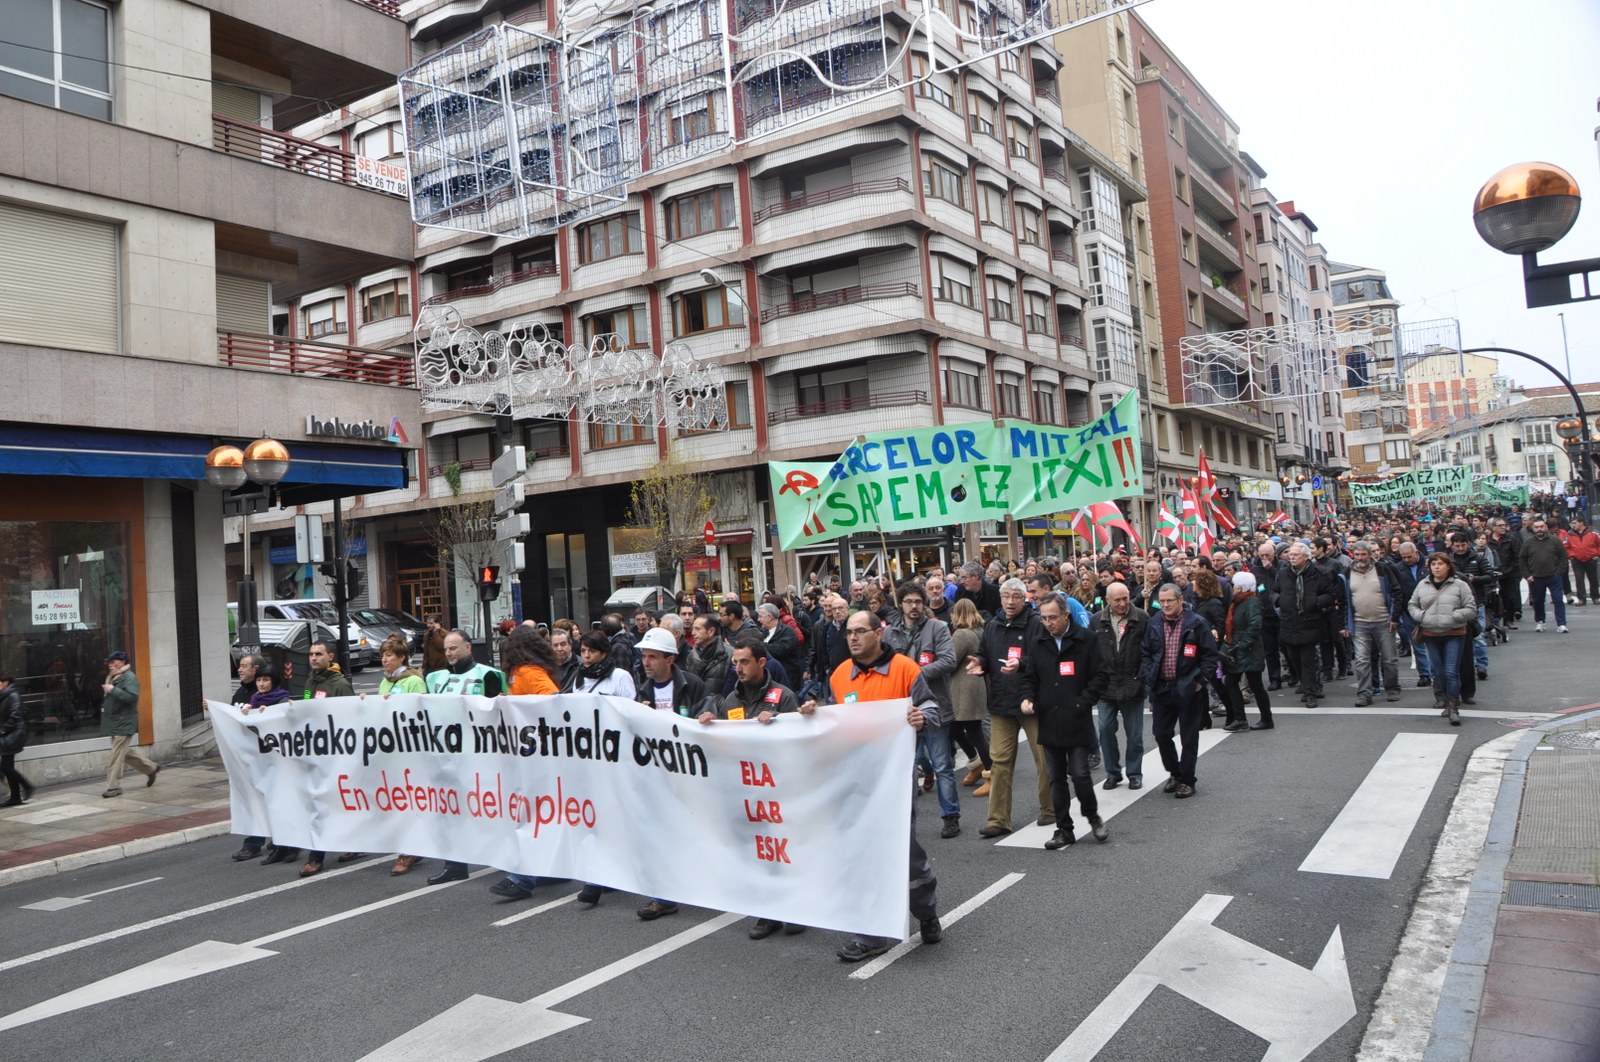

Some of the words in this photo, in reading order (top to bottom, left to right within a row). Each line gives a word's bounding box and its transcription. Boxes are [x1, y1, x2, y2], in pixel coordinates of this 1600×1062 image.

[359, 158, 371, 171] SE
[374, 161, 406, 181] VENDE
[358, 172, 373, 186] 945
[374, 176, 385, 188] 26
[386, 180, 395, 191] 77
[397, 182, 407, 194] 88
[305, 415, 386, 439] helvetia
[974, 464, 1012, 509] EZ
[1417, 470, 1434, 485] EZ
[34, 613, 48, 621] 945
[49, 612, 58, 621] 28
[59, 611, 68, 620] 99
[69, 611, 78, 619] 30
[363, 709, 463, 767] politika
[469, 708, 621, 763] industriala
[740, 760, 776, 788] ELA
[338, 774, 370, 811] En
[375, 768, 461, 815] defensa
[466, 772, 503, 819] del
[744, 799, 783, 824] LAB
[755, 835, 791, 864] ESK
